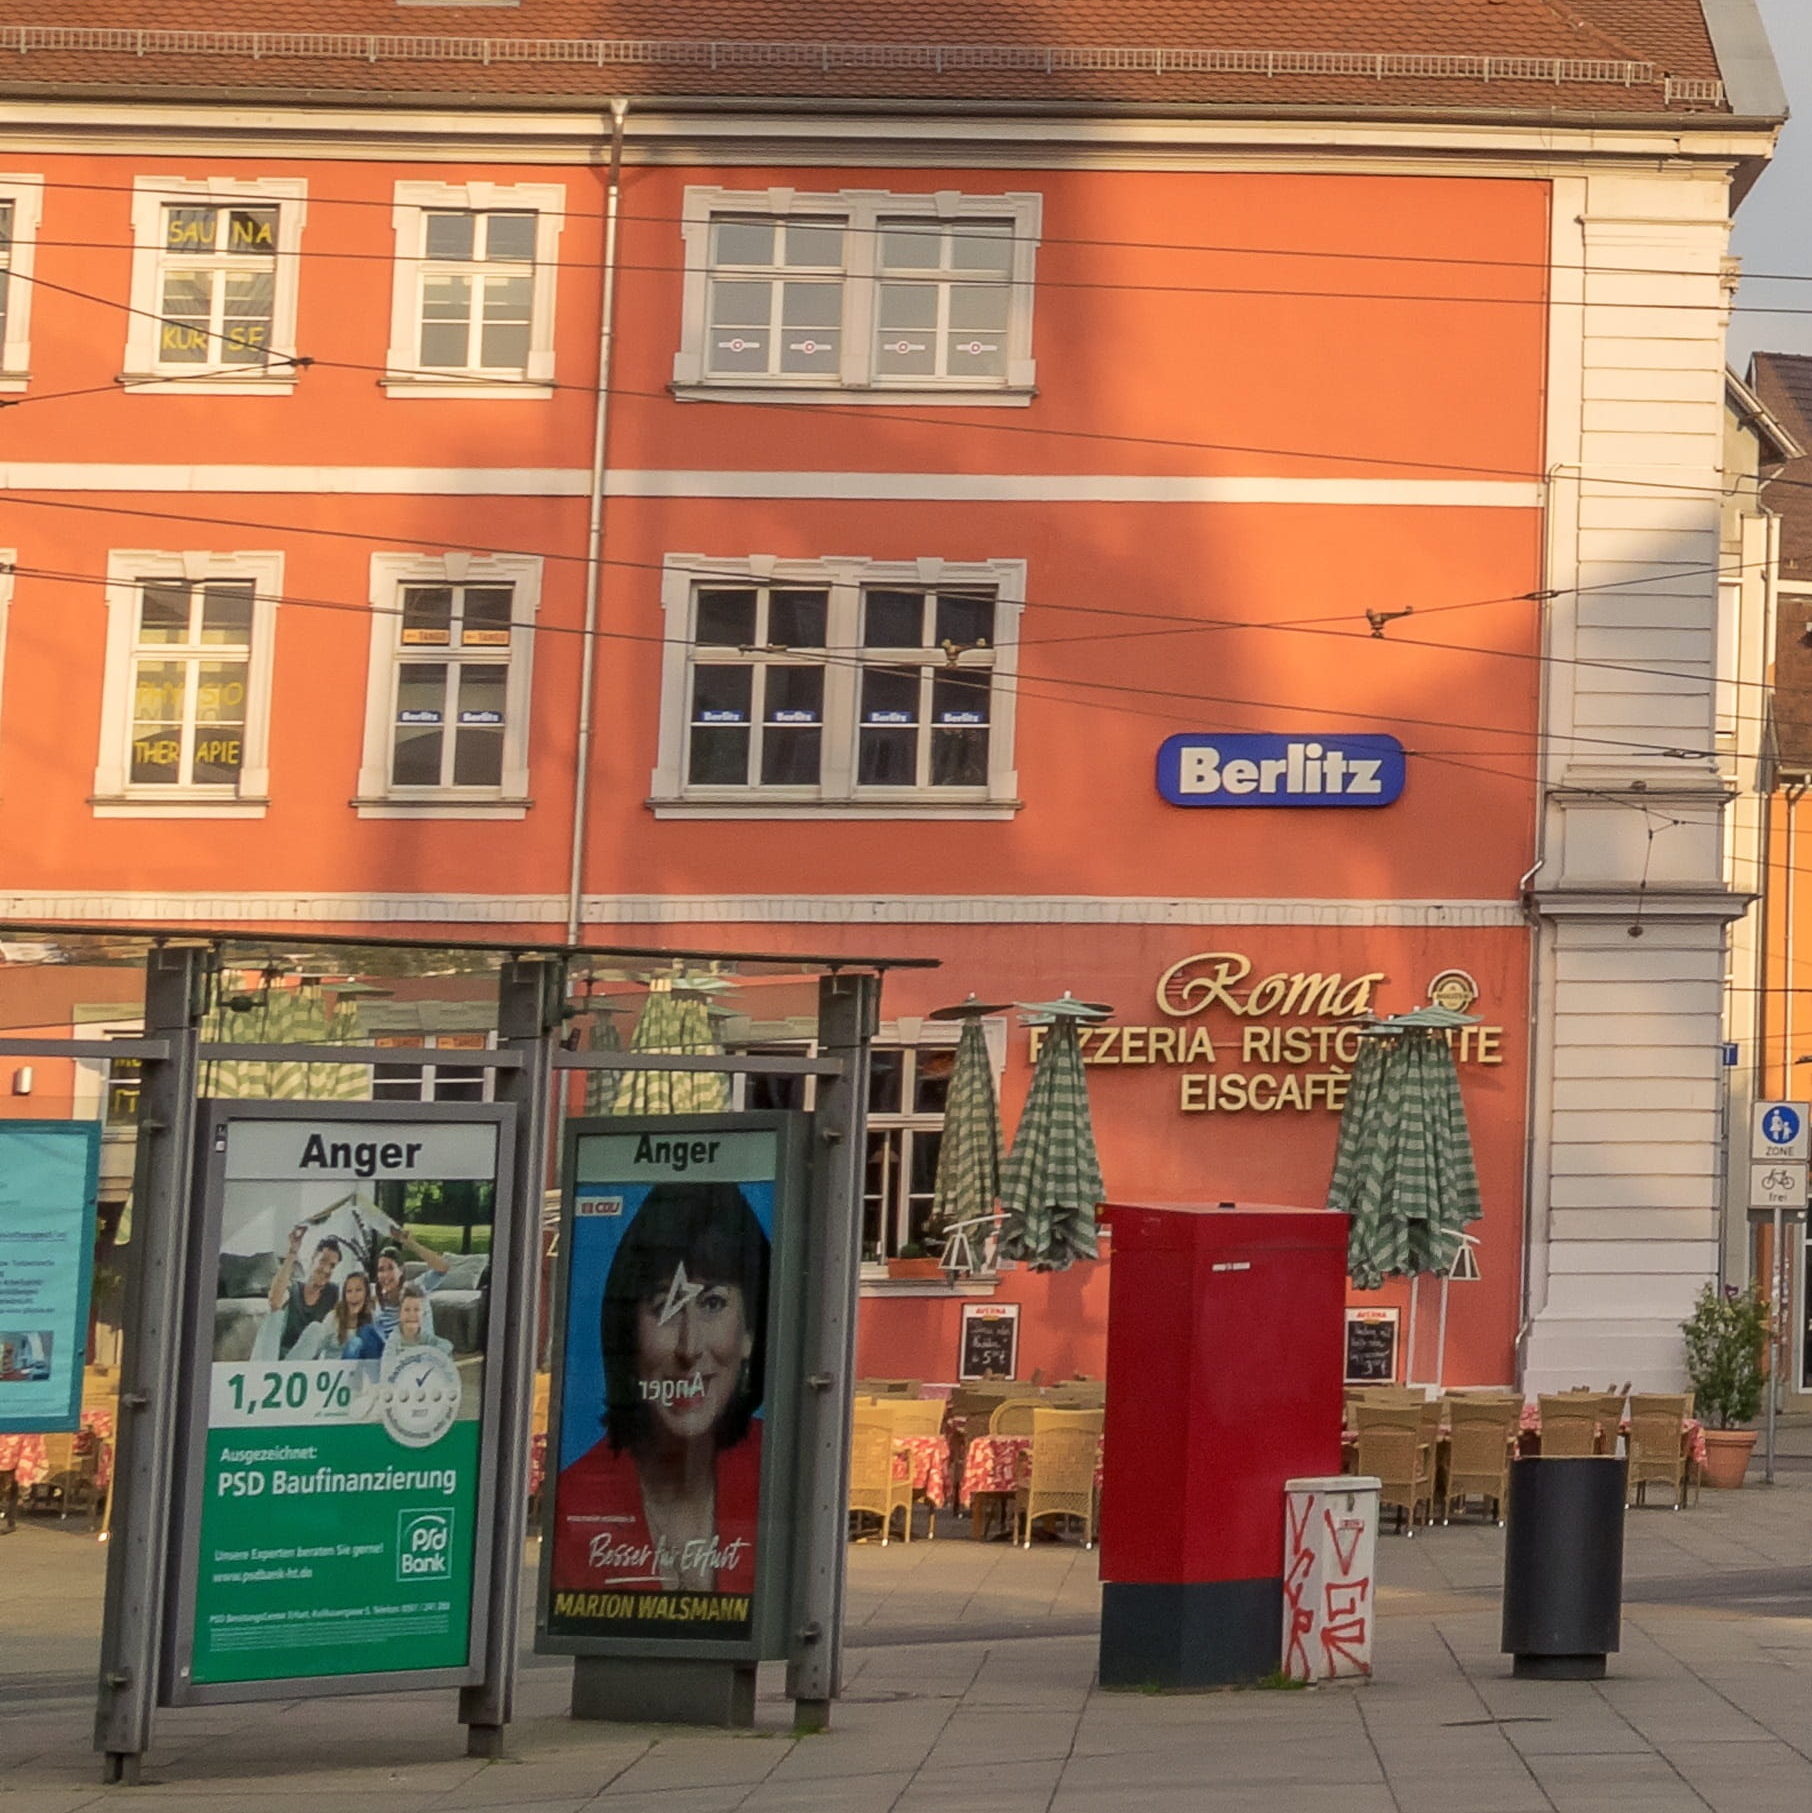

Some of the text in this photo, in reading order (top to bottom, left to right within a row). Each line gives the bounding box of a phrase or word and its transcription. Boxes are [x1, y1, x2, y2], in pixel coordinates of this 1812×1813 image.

[1179, 743, 1382, 794] Berlitz
[1155, 951, 1385, 1018] Roma
[1029, 1025, 1504, 1065] PZZERIA RISTOTE
[1180, 1064, 1353, 1111] EISCAFÈ
[299, 1133, 423, 1178] Anger
[633, 1132, 721, 1172] Anger
[1764, 1146, 1795, 1157] ZONE
[595, 1202, 620, 1214] CDU
[1768, 1191, 1788, 1203] frei
[228, 1369, 351, 1416] 1,20 %
[220, 1445, 318, 1466] Ausgezeichnet:
[217, 1464, 457, 1497] PSD Baufinanzierung
[401, 1552, 446, 1574] Bank
[588, 1532, 653, 1568] Besser
[680, 1534, 752, 1577] Erfurt
[553, 1593, 750, 1622] MARION WALSMANN
